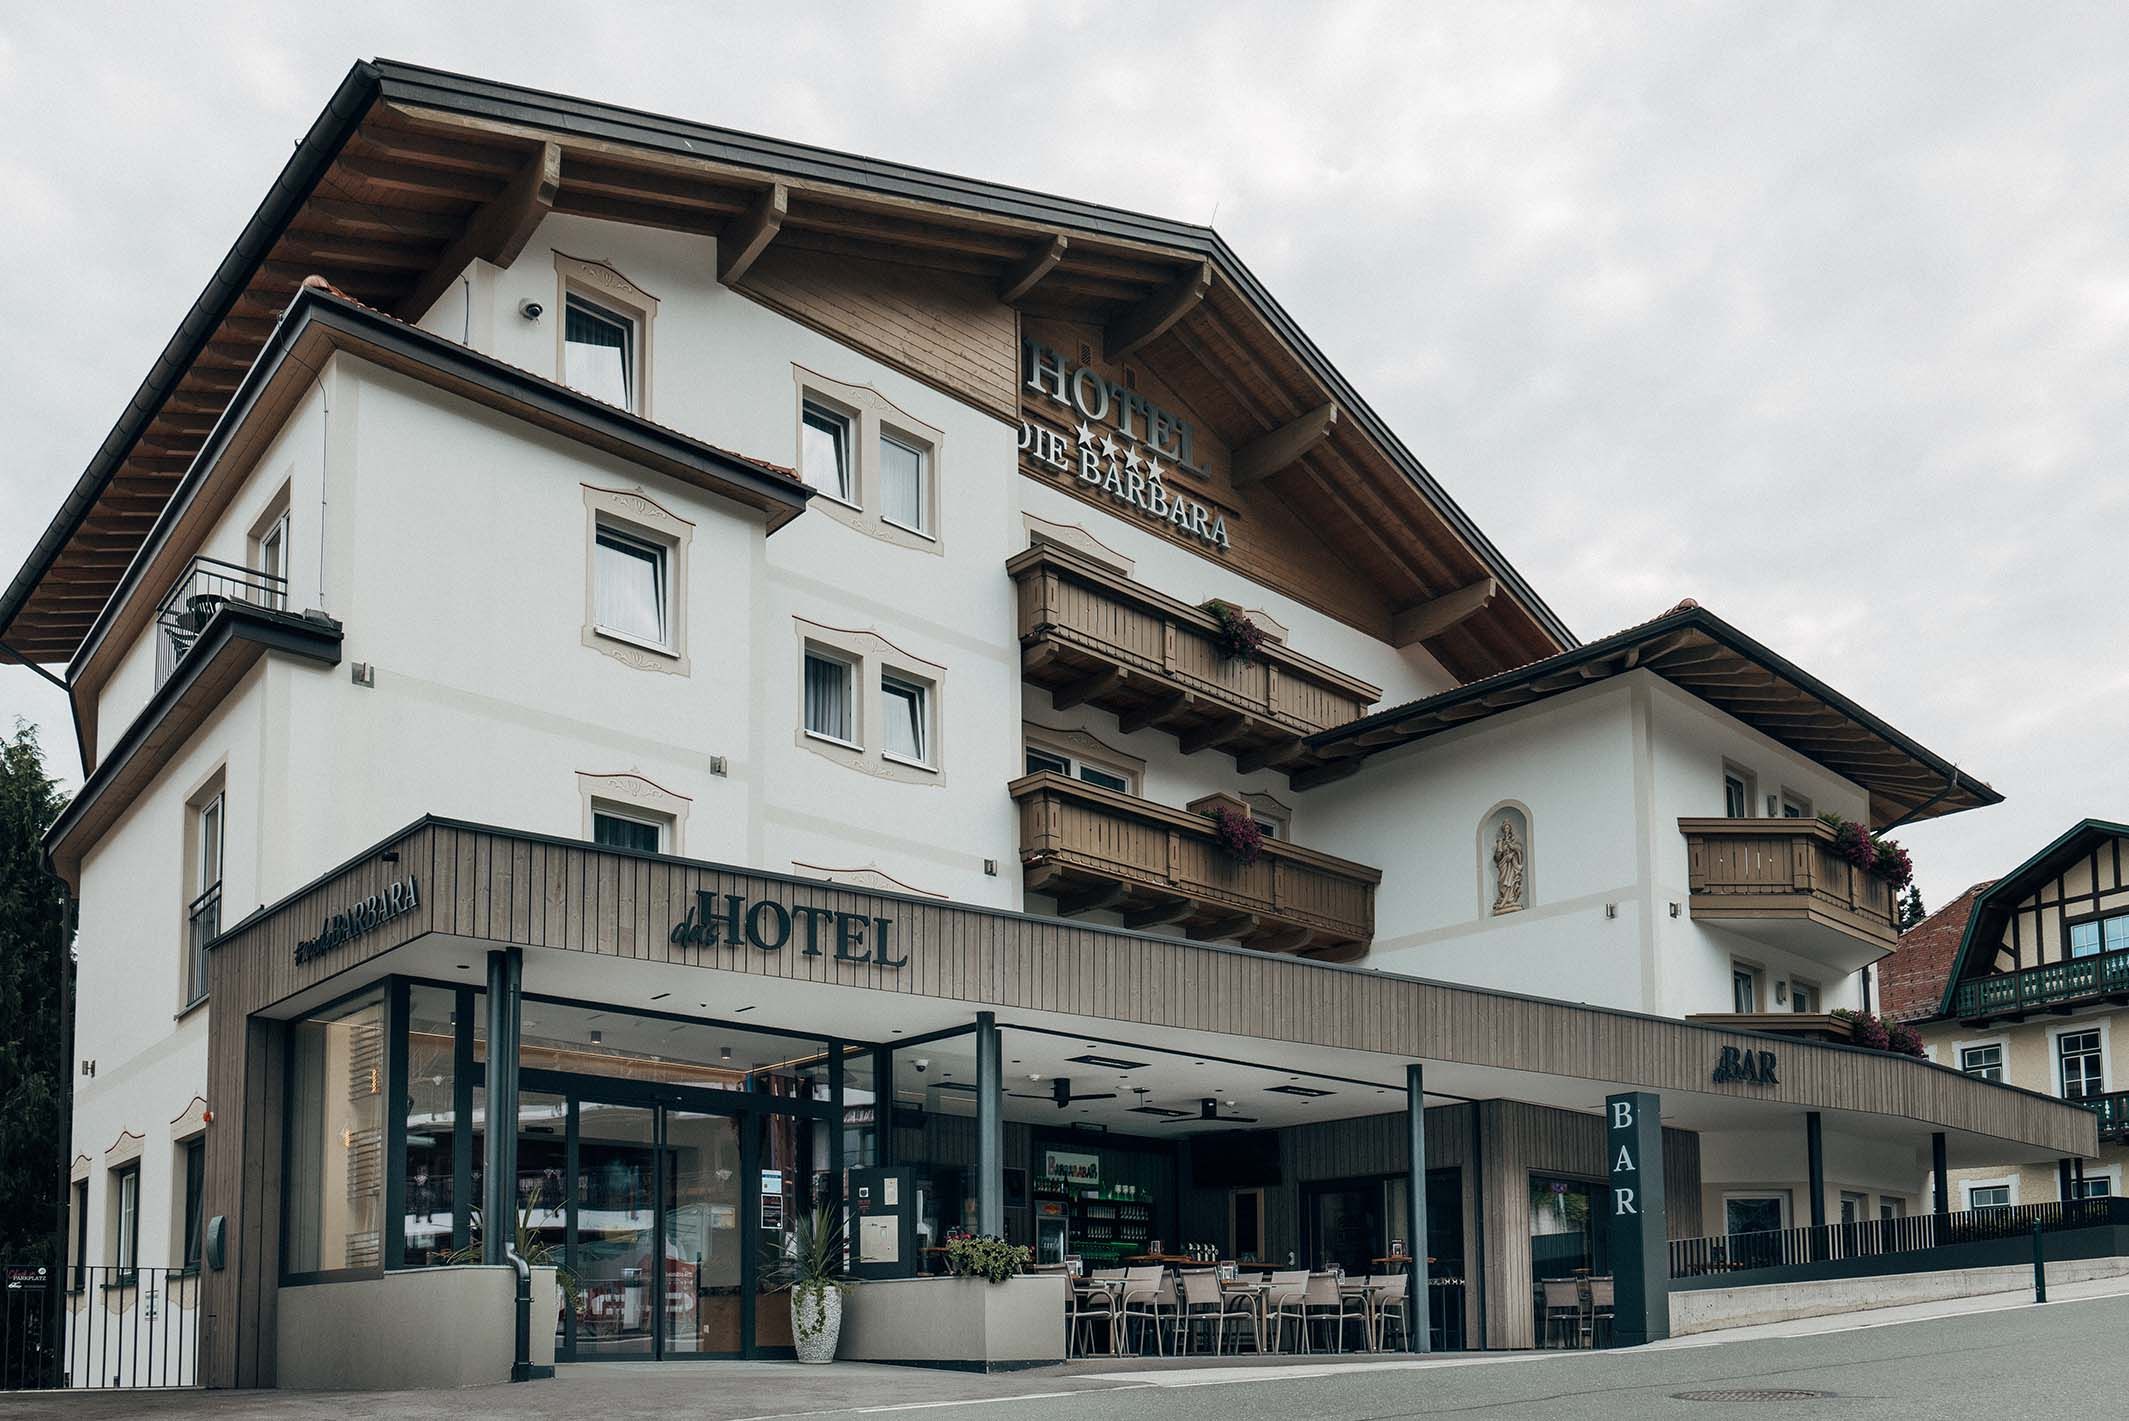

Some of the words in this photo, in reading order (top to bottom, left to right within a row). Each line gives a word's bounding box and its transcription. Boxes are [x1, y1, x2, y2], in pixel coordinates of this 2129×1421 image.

[1023, 337, 1213, 480] HOTEL
[1079, 446, 1231, 549] BARBARA
[331, 874, 418, 945] BARBARA
[696, 890, 908, 968] HOTEL
[1722, 1046, 1779, 1084] BAR
[1612, 1102, 1637, 1215] BAR
